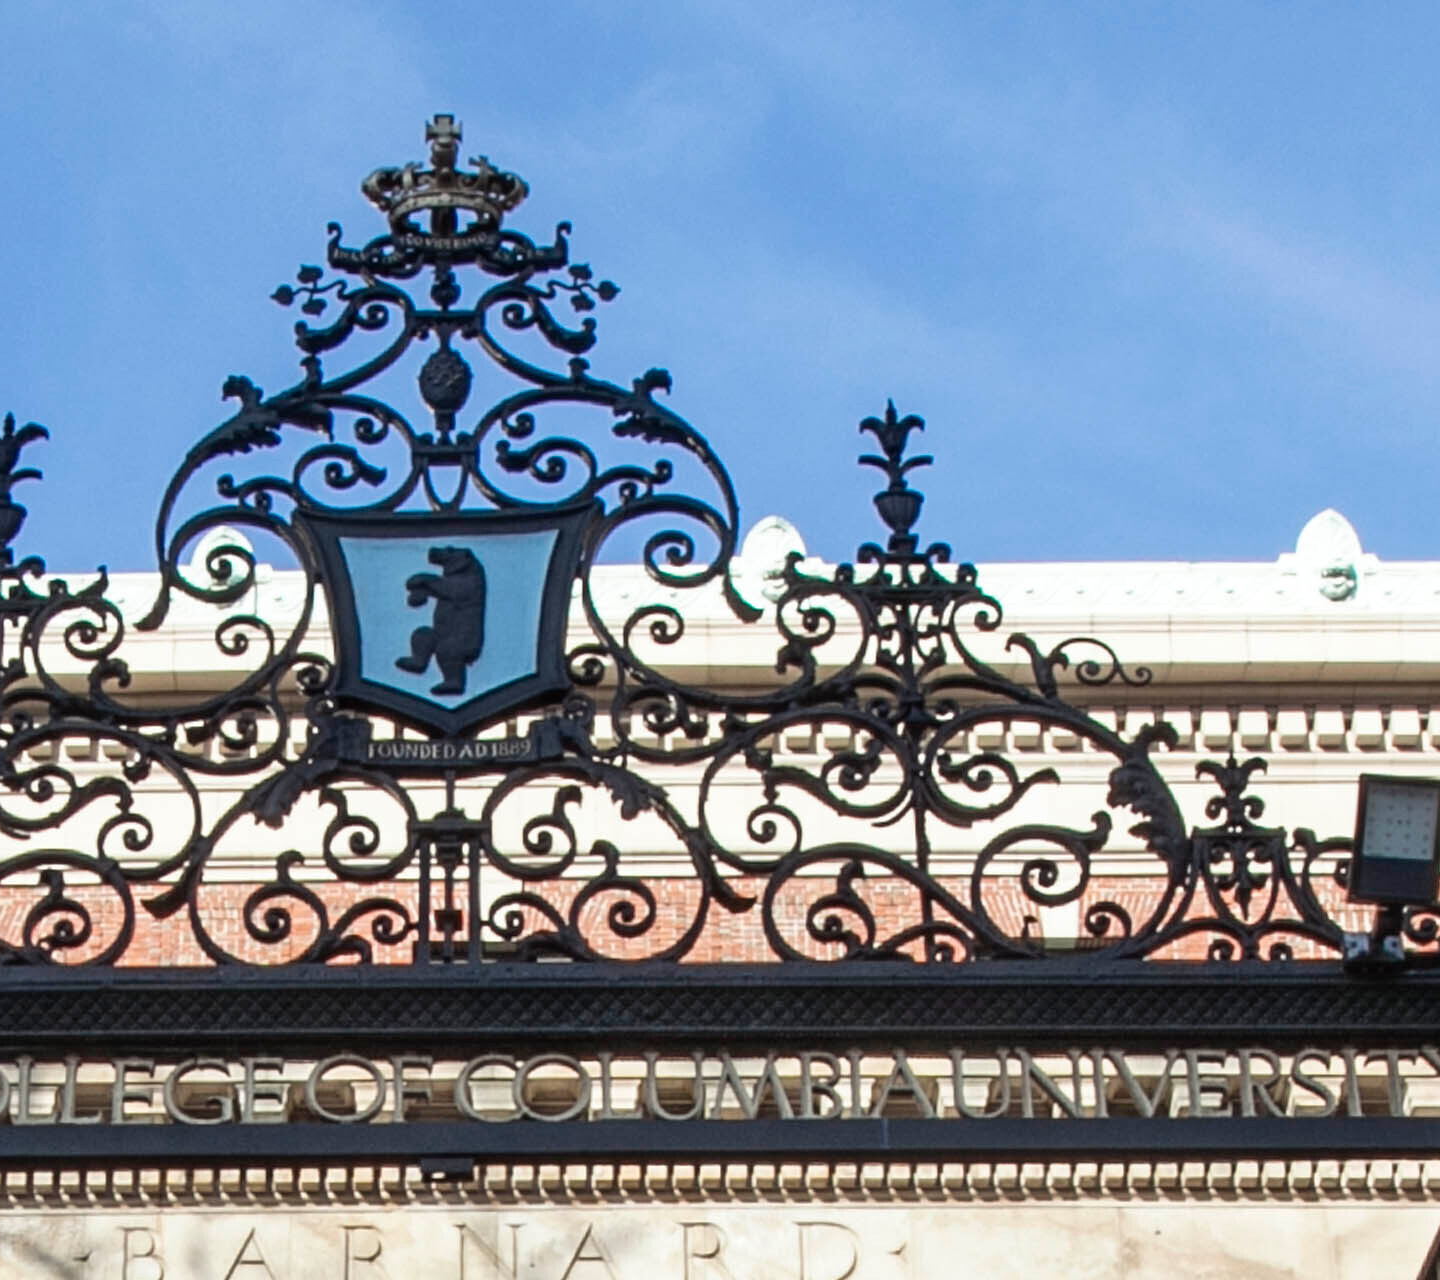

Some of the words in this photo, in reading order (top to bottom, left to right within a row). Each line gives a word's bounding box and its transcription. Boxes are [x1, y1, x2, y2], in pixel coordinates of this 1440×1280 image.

[367, 742, 457, 760] FOUNDED
[491, 739, 532, 759] 1889
[305, 1051, 434, 1124] OF
[454, 1047, 940, 1123] COLUMBIA
